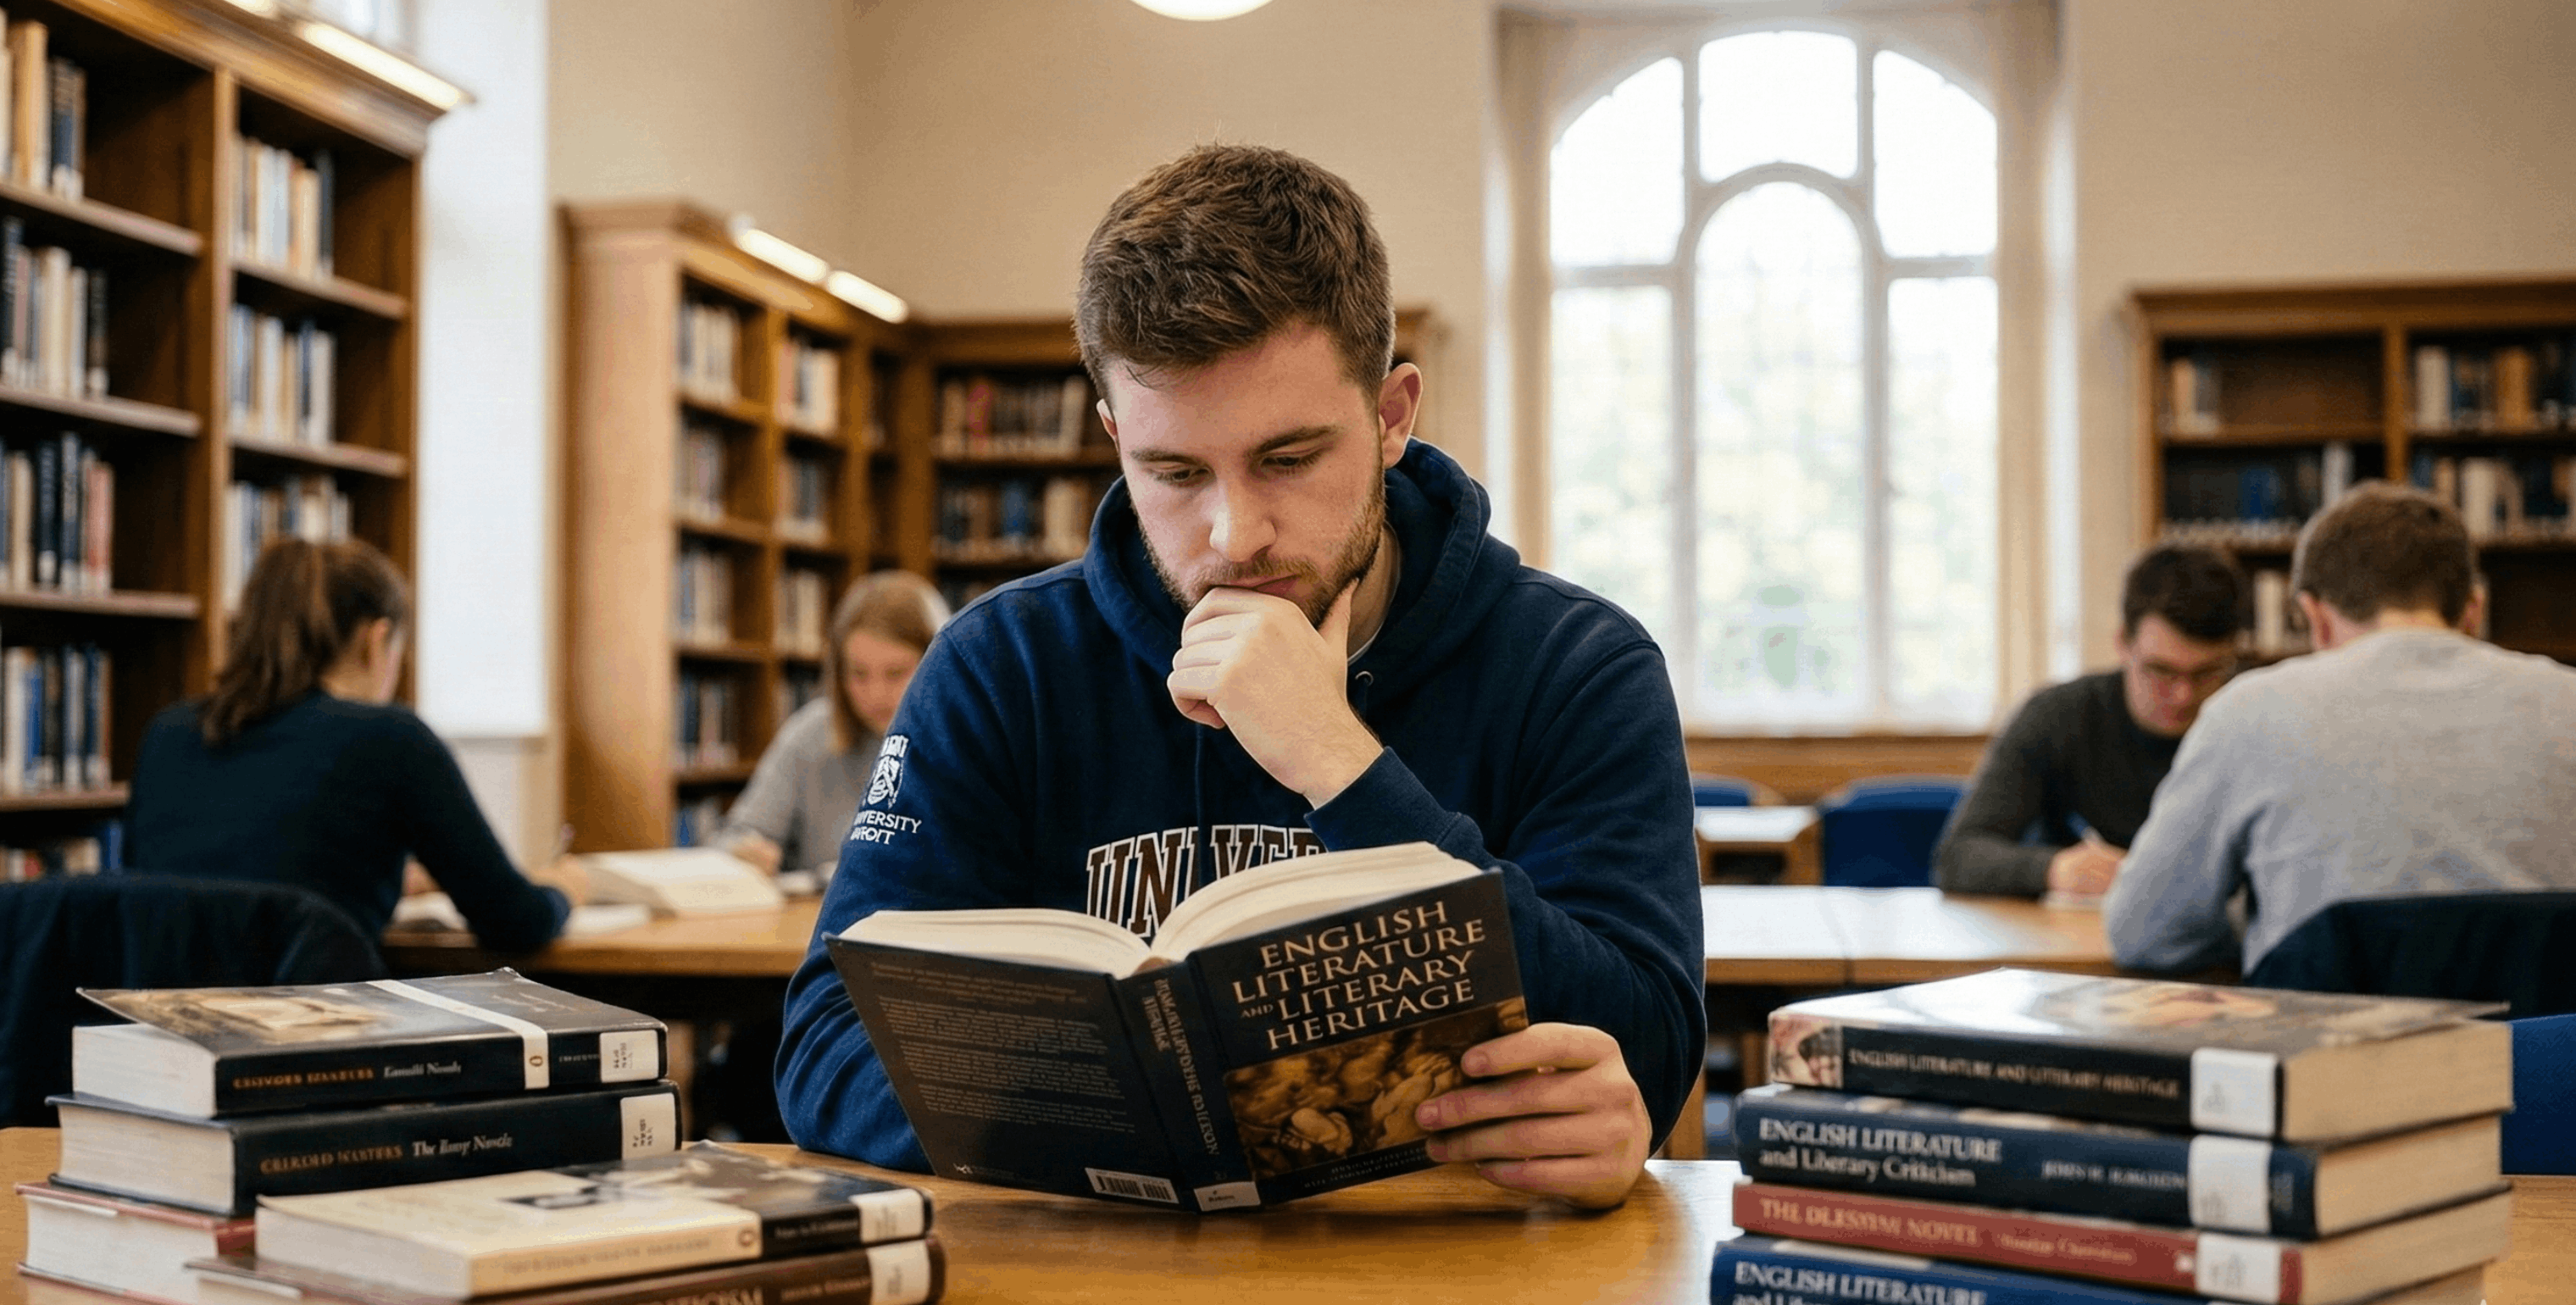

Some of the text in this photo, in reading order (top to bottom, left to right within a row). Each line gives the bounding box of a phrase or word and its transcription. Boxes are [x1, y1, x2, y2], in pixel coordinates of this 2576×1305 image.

[1233, 919, 1485, 1003] LITERATURE
[1261, 901, 1446, 968] ENGLISH
[1242, 950, 1474, 1020] AND LITERARY
[1267, 979, 1474, 1050] HERITAGE
[1759, 1118, 2002, 1163] ENGLISH LITERATURE
[1759, 1146, 1797, 1169] and
[1735, 1261, 1988, 1305] ENGLISH LITERATURE
